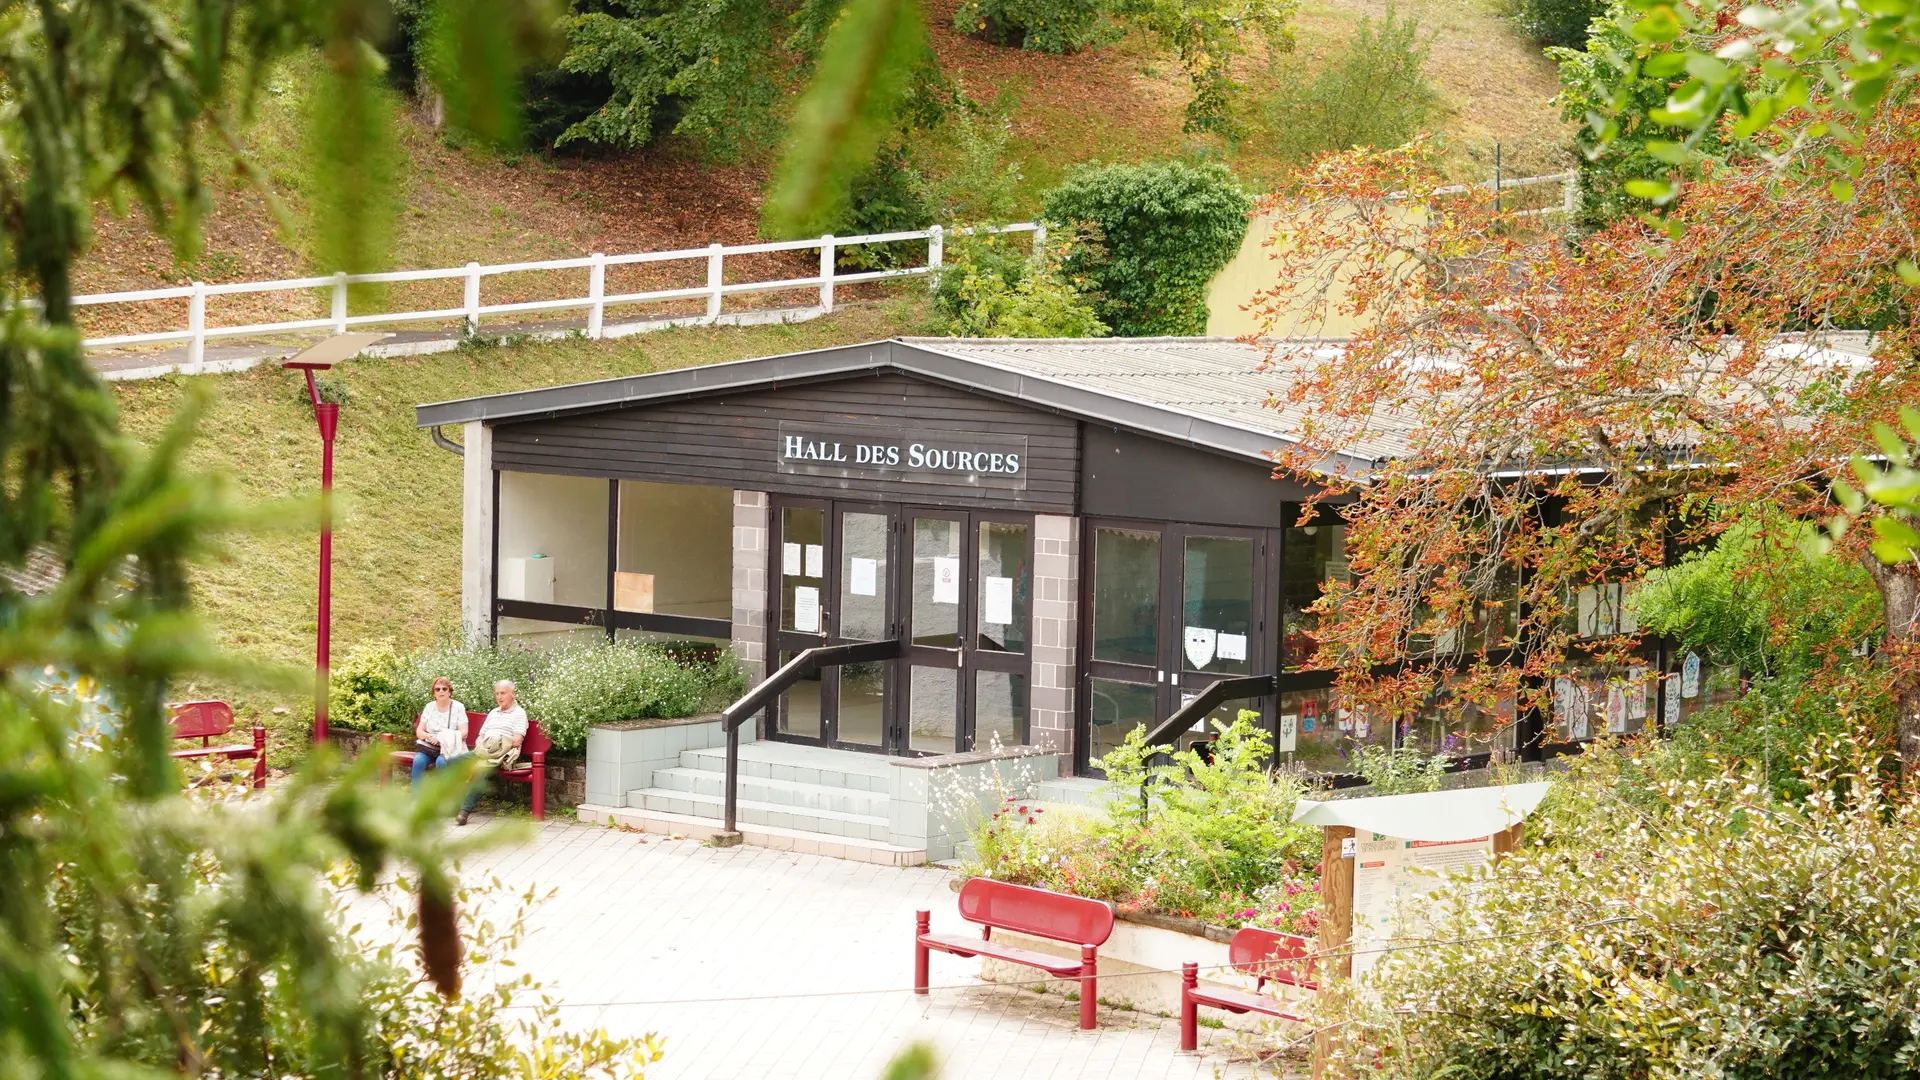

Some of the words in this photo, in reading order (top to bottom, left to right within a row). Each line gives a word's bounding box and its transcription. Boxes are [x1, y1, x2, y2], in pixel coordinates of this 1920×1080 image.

[784, 435, 847, 462] HALL
[855, 444, 900, 466] DES
[907, 443, 1020, 474] SOURCES
